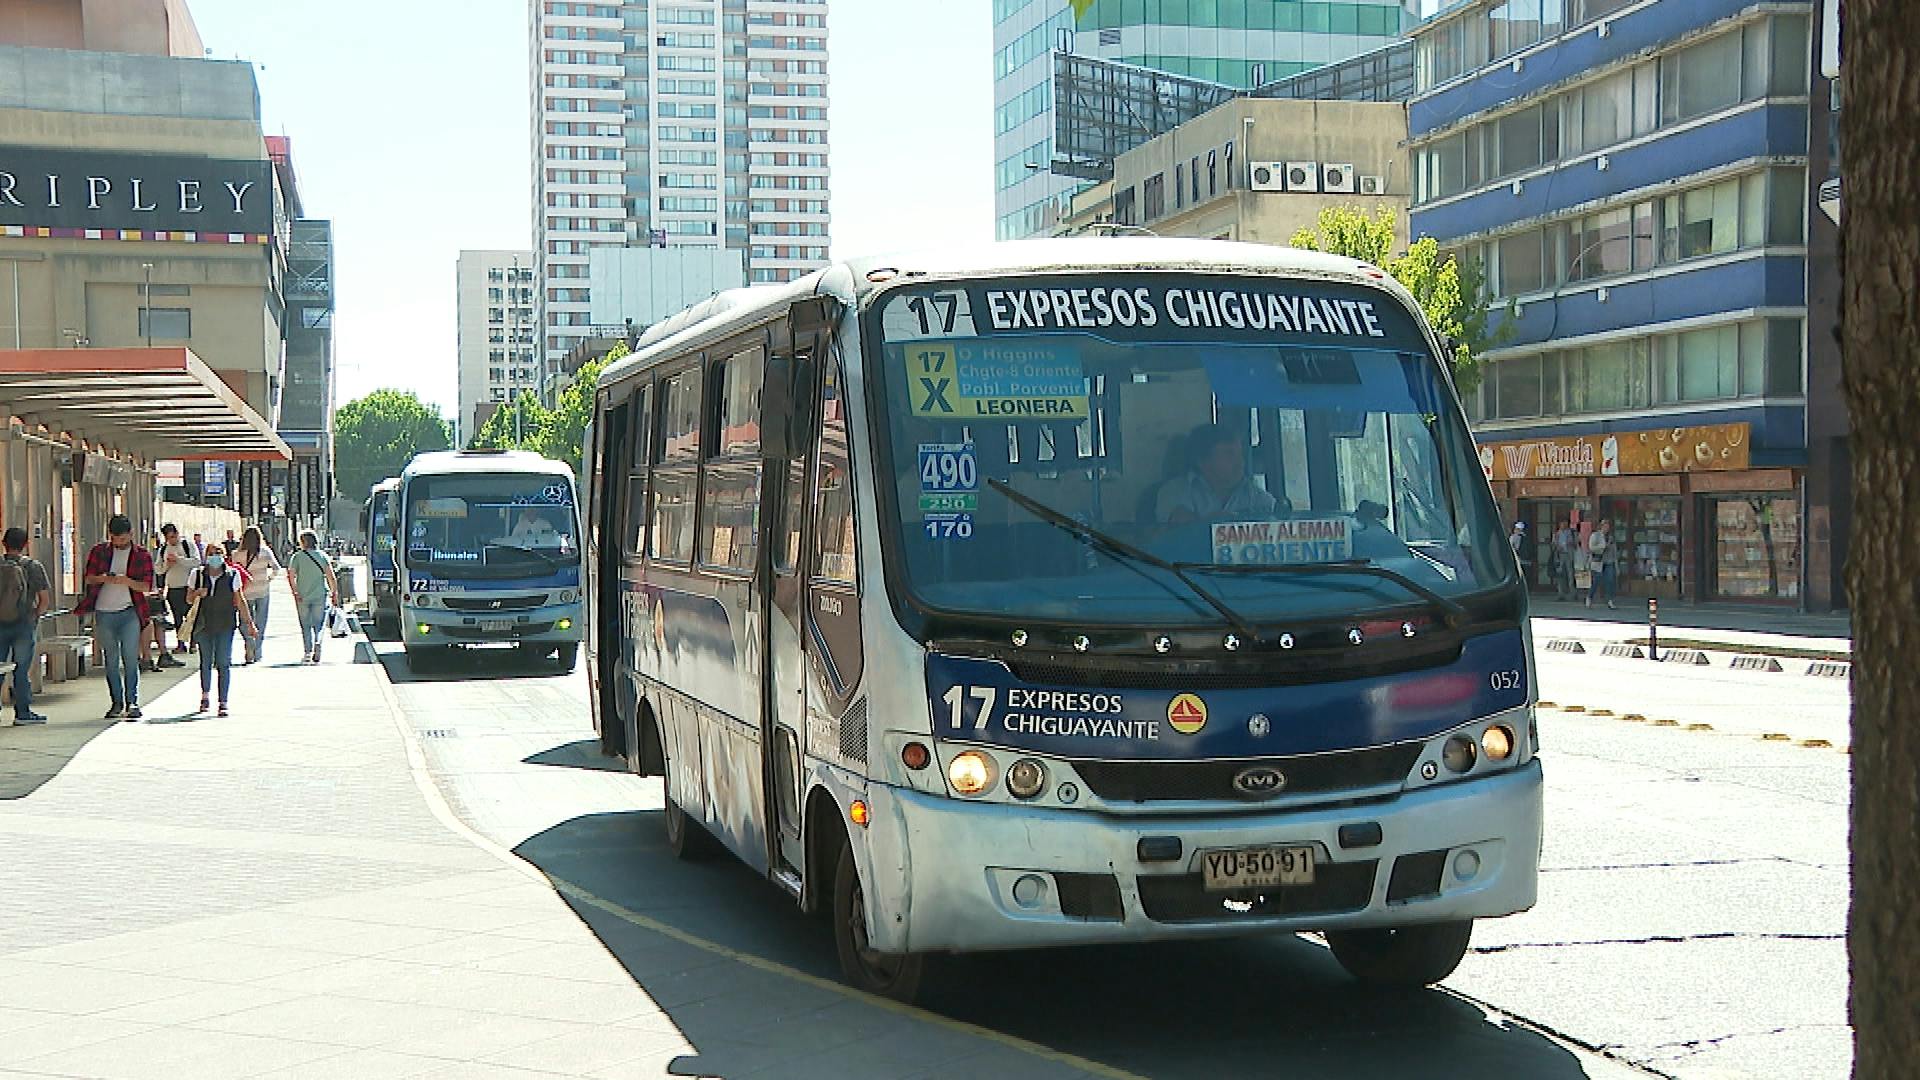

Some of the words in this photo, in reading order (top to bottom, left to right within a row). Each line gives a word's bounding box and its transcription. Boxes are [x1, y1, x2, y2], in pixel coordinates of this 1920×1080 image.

[0, 171, 254, 213] RIPLEY
[907, 292, 958, 335] 17
[986, 288, 1157, 329] EXPRESOS
[1165, 289, 1384, 337] CHIGUAYANTE
[918, 351, 947, 373] 17
[1023, 365, 1081, 379] Oriente
[919, 377, 954, 413] X
[1010, 382, 1081, 396] Porvenir
[976, 399, 1075, 416] LEONERA
[922, 453, 977, 489] 490
[926, 521, 973, 537] 170
[1278, 520, 1345, 541] ALEMAN
[1240, 541, 1345, 564] ORIENTE
[412, 579, 428, 591] 72
[1491, 670, 1520, 690] 052
[943, 685, 996, 730] 17
[1008, 689, 1122, 713] EXPRESOS
[1004, 713, 1160, 740] CHIGUAYANTE
